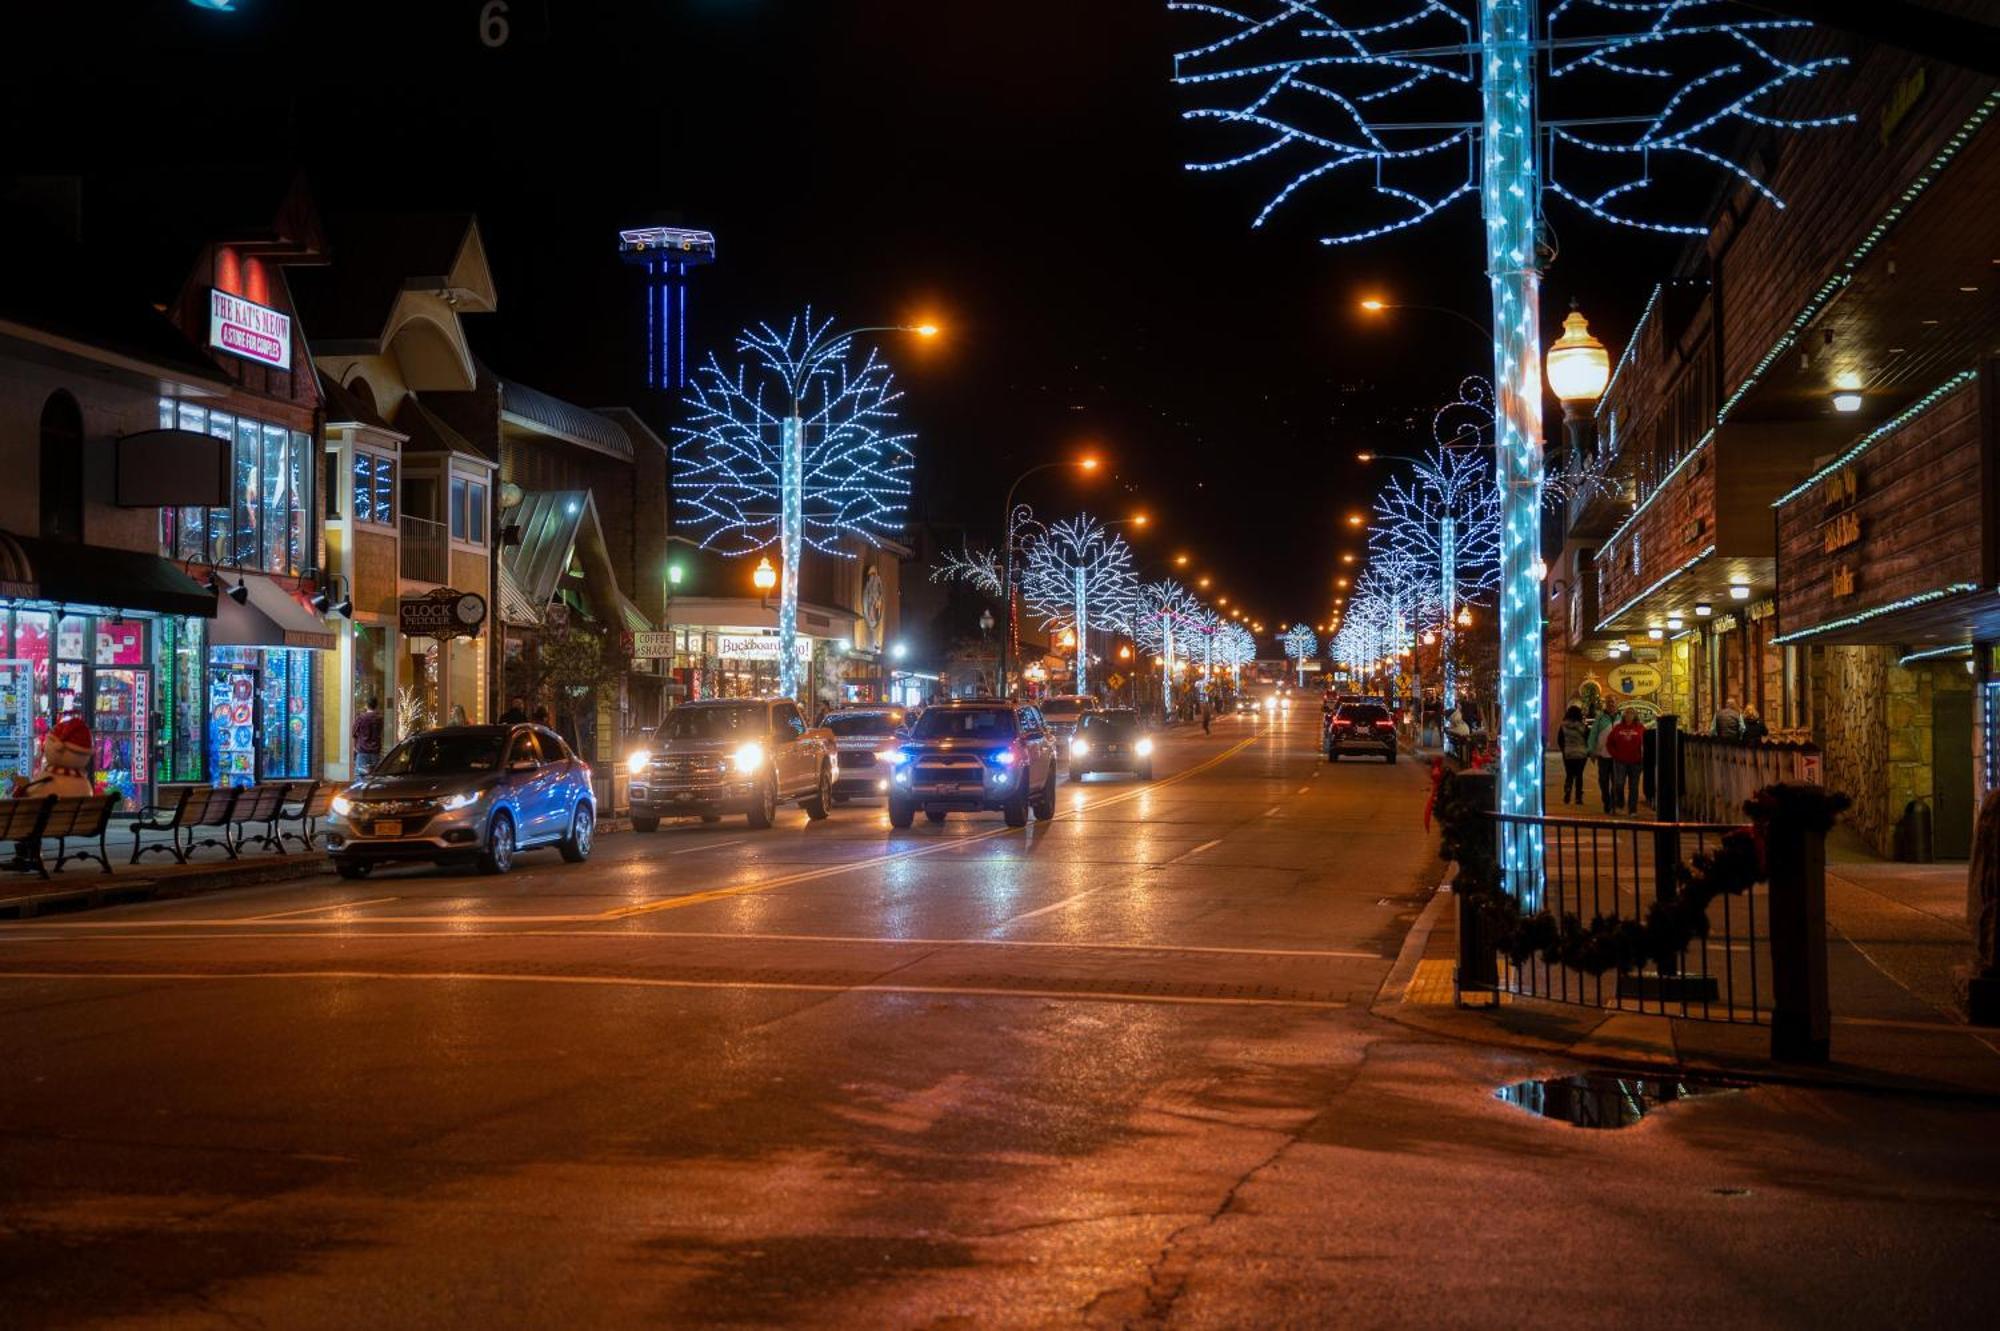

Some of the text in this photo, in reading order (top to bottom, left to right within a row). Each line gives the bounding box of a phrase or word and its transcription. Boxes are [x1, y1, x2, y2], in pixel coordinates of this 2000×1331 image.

[479, 0, 511, 48] 6
[214, 294, 288, 338] THE KAT'S MEOW
[229, 326, 247, 348] STORE
[248, 334, 257, 350] FOR
[258, 338, 279, 358] COUPLES
[401, 605, 449, 616] CLOCK
[405, 616, 449, 624] PEDDLER
[639, 634, 673, 644] COFFEE
[637, 645, 672, 657] SHACK
[136, 675, 145, 779] HENNA TATTOOS
